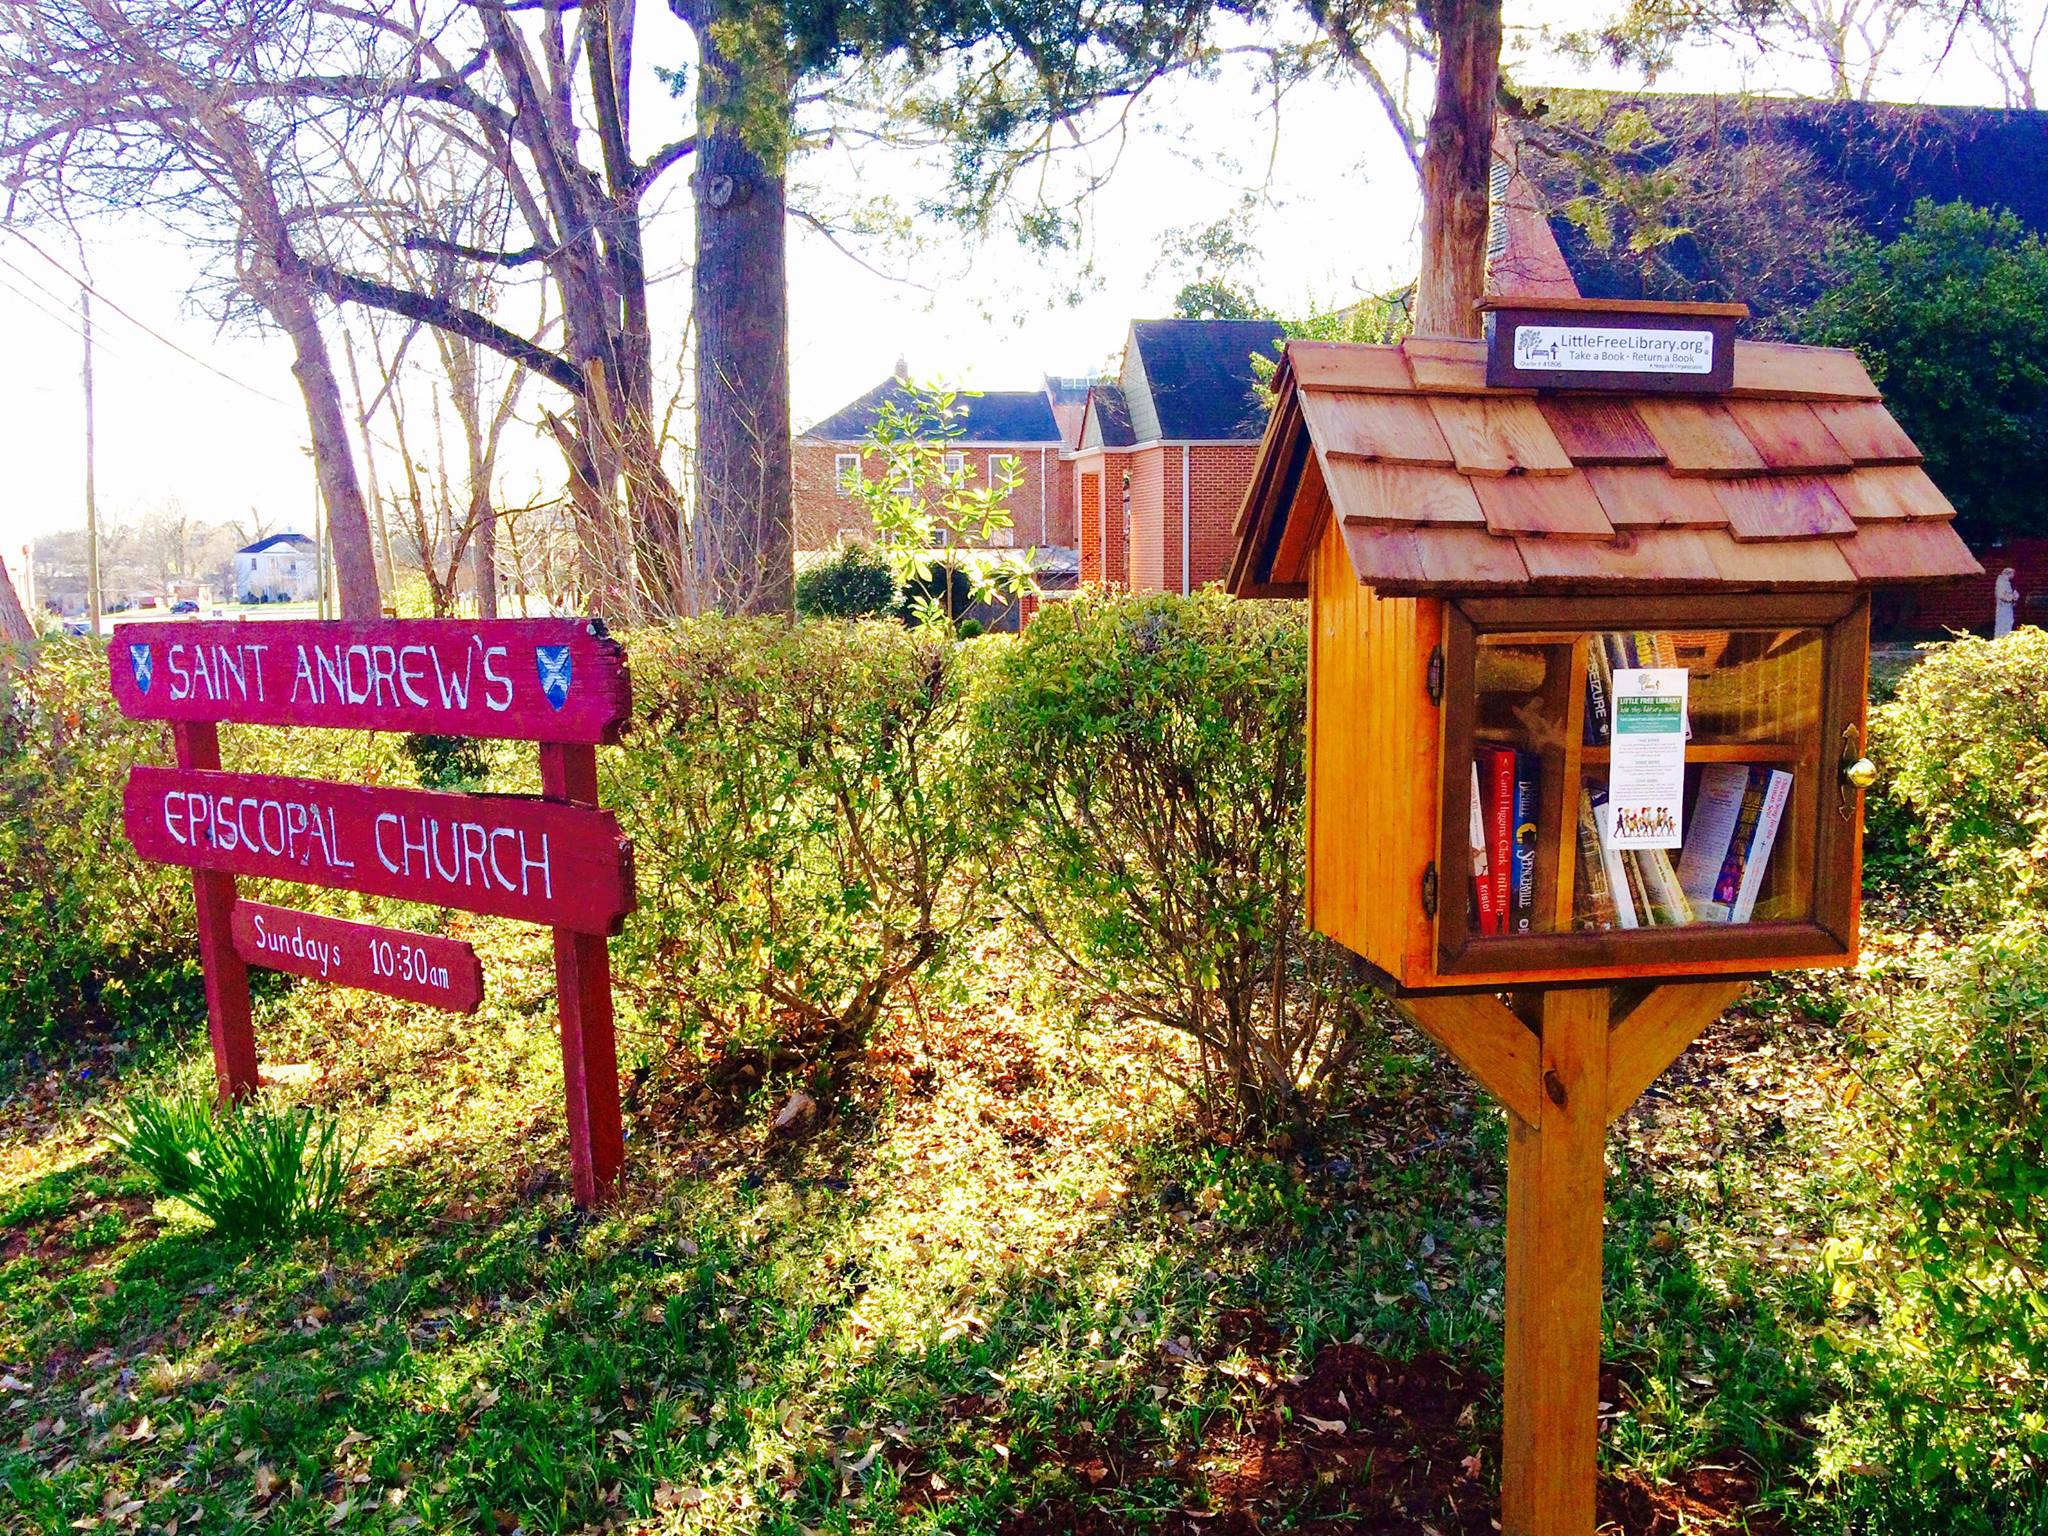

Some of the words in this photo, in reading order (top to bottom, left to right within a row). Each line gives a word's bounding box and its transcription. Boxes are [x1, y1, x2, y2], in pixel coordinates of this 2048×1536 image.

[1561, 334, 1703, 353] LittleFreeLibrary.org
[1569, 350, 1591, 360] Take
[1601, 351, 1625, 361] Book
[1632, 352, 1662, 362] Return
[1672, 353, 1695, 362] Book
[168, 644, 268, 702] SAINT
[290, 636, 514, 712] ANDREW'S
[1588, 662, 1606, 719] SEIZURE
[1500, 770, 1511, 798] Carol
[1497, 800, 1510, 837] Higgins
[164, 791, 354, 867] EPISCOPAL
[375, 813, 552, 899] CHURCH
[1498, 840, 1509, 866] Clark
[1516, 849, 1536, 909] SPENCERVILLE
[1480, 884, 1491, 913] Kristof
[254, 914, 341, 978] Sundays
[369, 938, 449, 990] 10:30am
